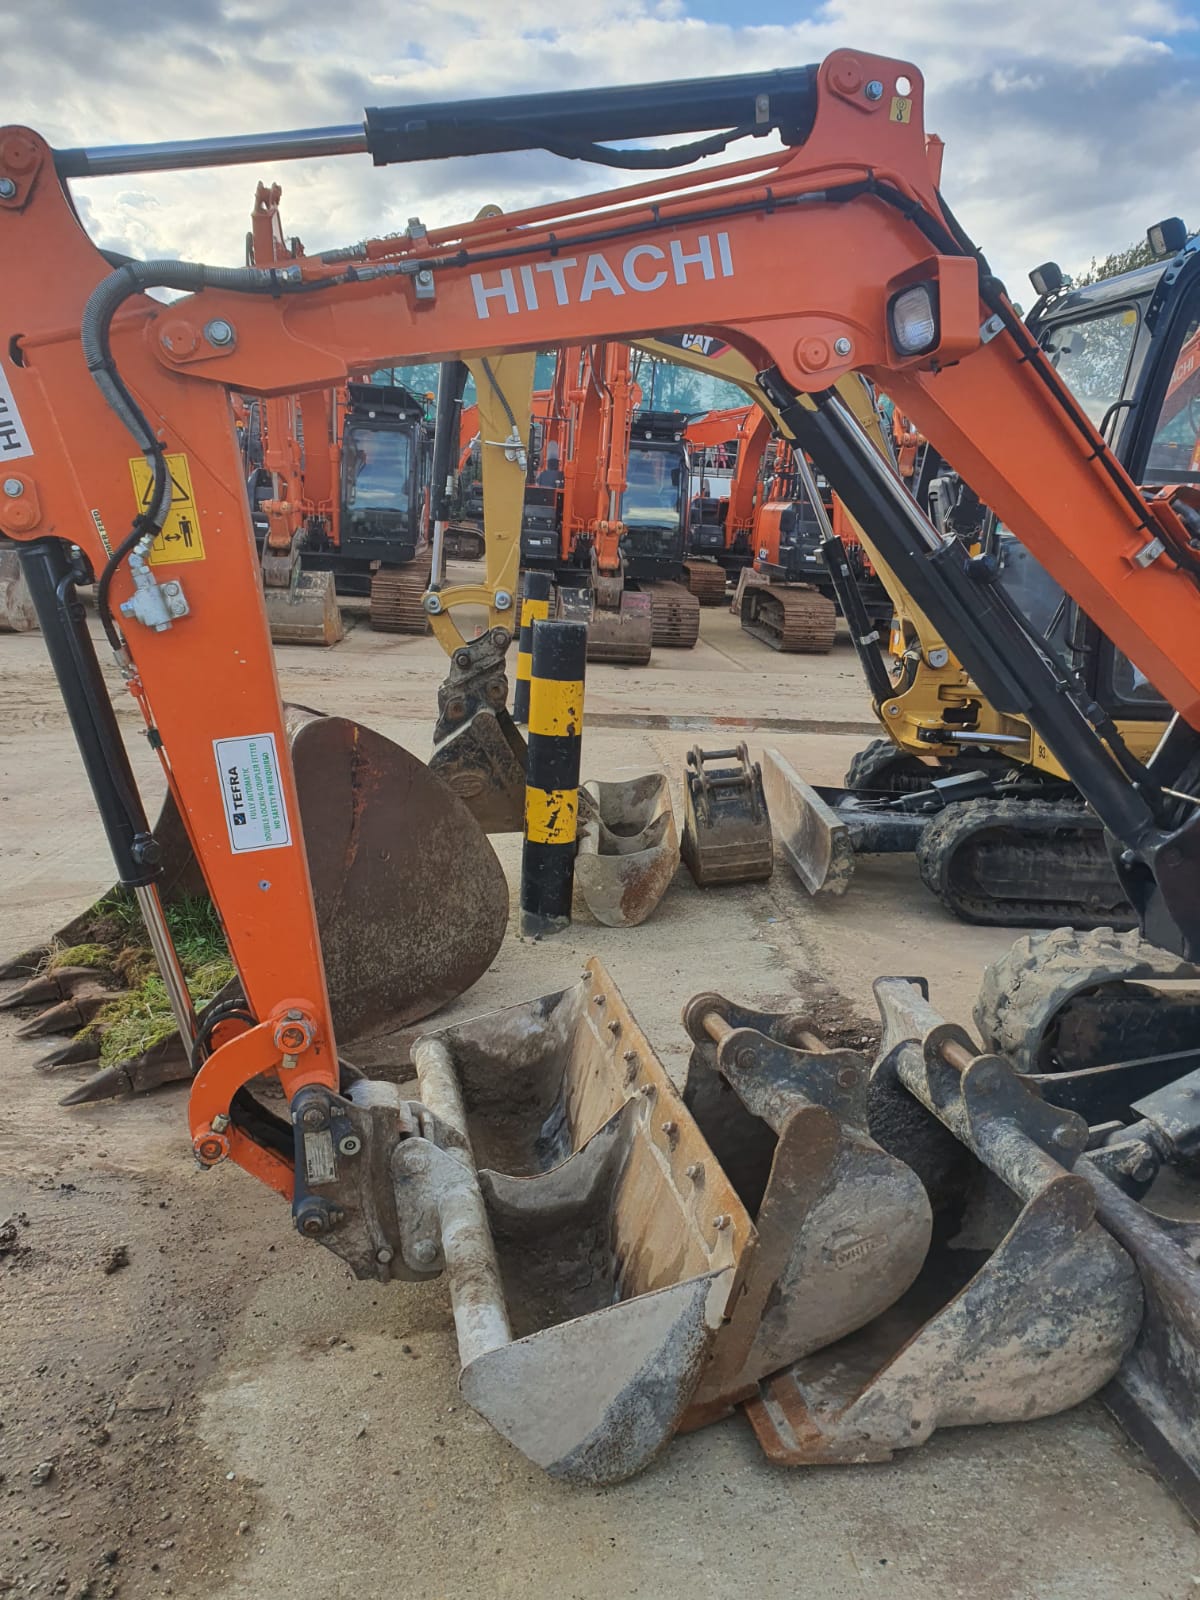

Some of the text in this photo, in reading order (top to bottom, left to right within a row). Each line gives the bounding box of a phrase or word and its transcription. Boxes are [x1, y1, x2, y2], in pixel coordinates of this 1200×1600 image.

[470, 232, 734, 319] HITACHI
[681, 333, 713, 354] CAT
[248, 742, 259, 763] FITTED
[227, 766, 244, 810] TEFRA
[252, 764, 263, 791] COUPLER
[242, 767, 258, 820] FULLY AUTOMATIC
[269, 797, 280, 819] SAFETY
[273, 820, 281, 829] NO
